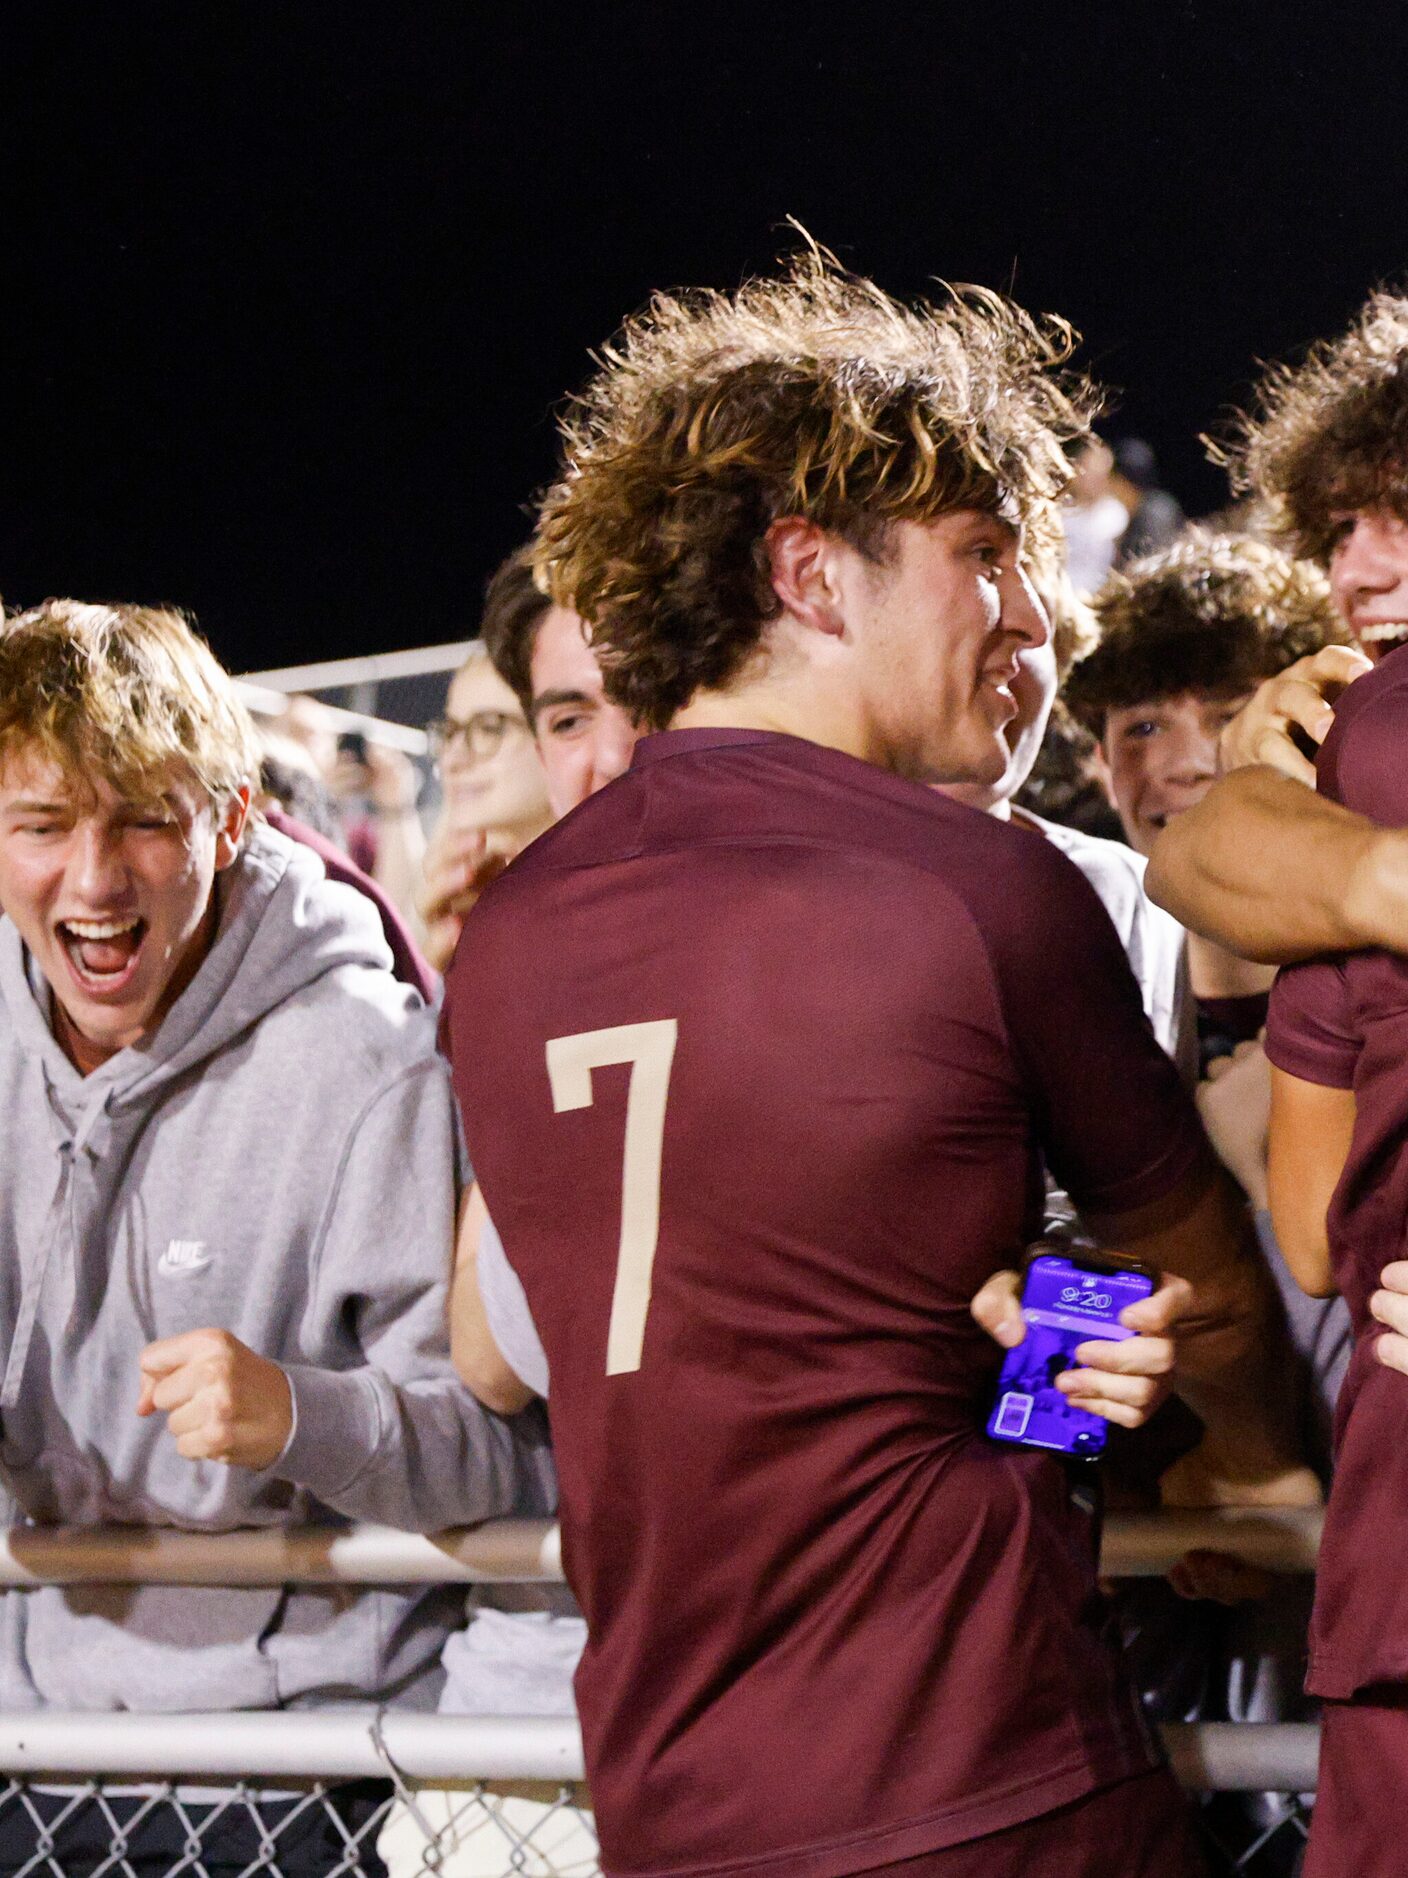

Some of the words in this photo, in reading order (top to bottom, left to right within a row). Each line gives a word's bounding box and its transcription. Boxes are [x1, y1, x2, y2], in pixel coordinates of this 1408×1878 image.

[546, 1018, 678, 1376] 7
[167, 1240, 208, 1263] NIKE
[1060, 1286, 1113, 1309] 9:20
